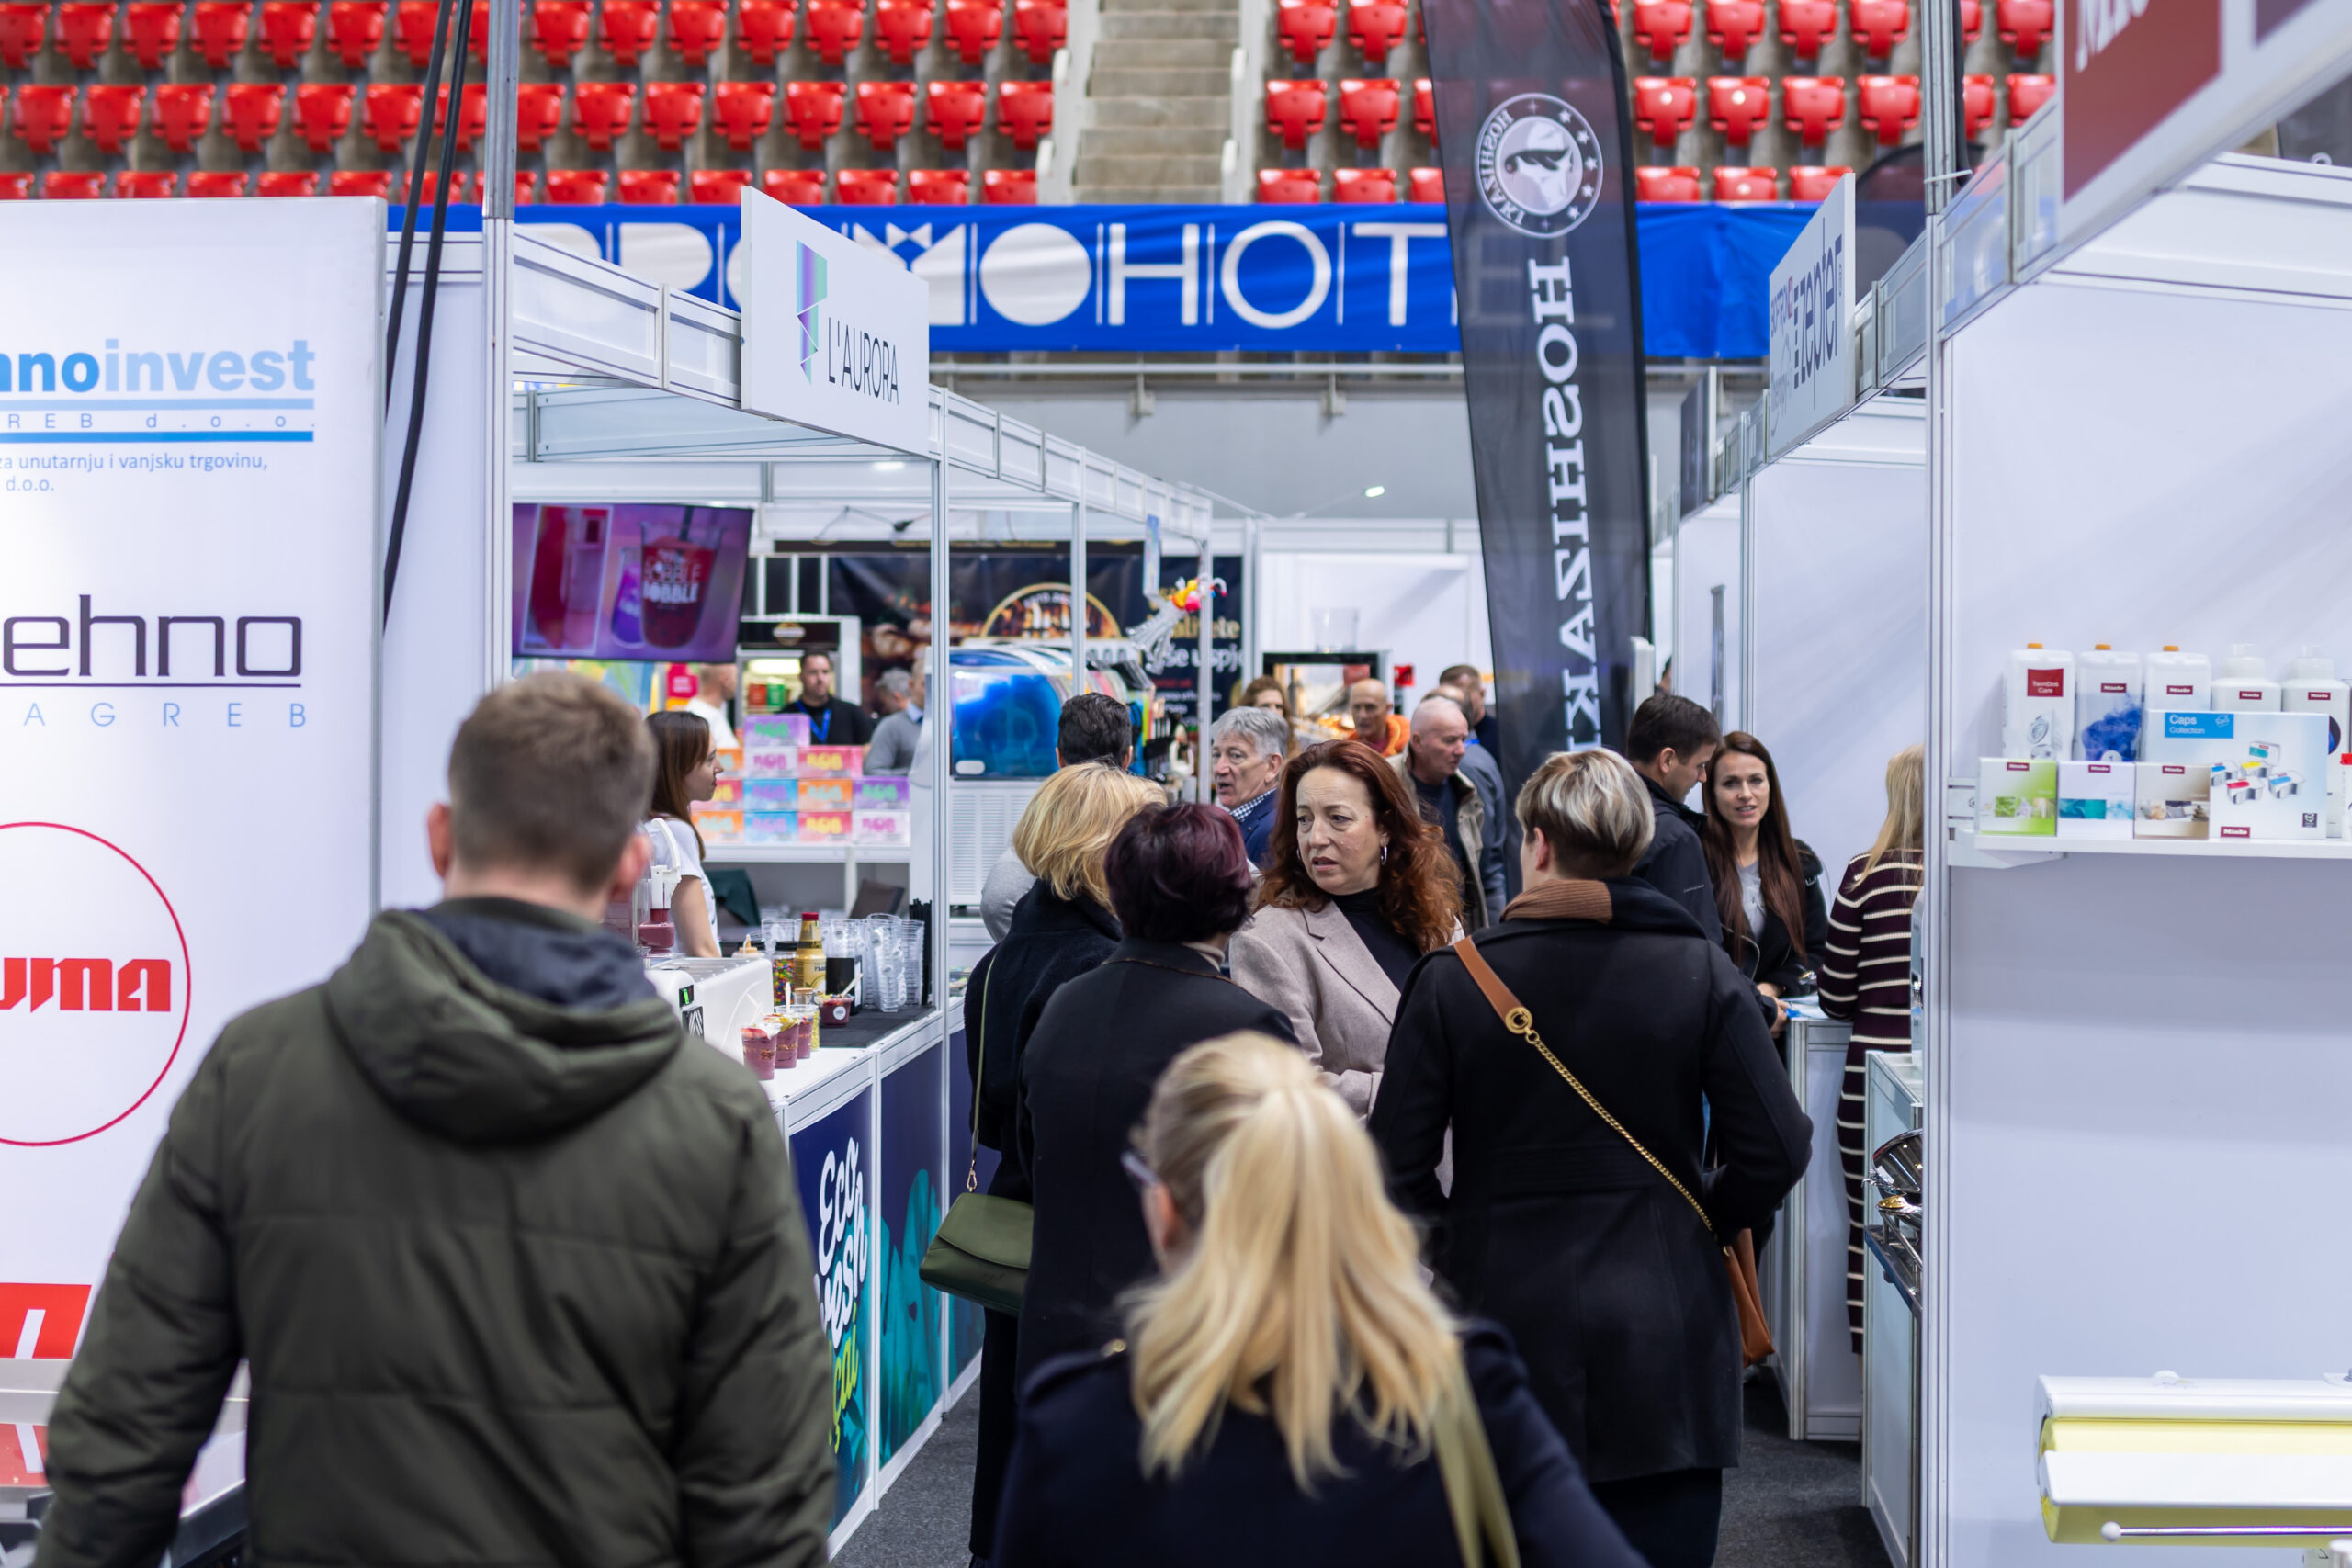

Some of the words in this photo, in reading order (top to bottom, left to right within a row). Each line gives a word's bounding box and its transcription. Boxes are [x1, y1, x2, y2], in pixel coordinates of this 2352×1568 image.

[1800, 217, 1843, 410] zepter
[828, 317, 899, 405] L'AURORA
[19, 454, 104, 472] unutarnju
[109, 453, 114, 469] i
[119, 453, 184, 472] vanjsku
[190, 453, 267, 472] trgovinu,
[6, 475, 55, 491] d.o.o.
[4, 594, 301, 678] ehno
[23, 701, 308, 728] AGREB
[2169, 715, 2198, 727] Caps
[2169, 727, 2206, 735] Collection
[818, 1136, 860, 1277] Eco
